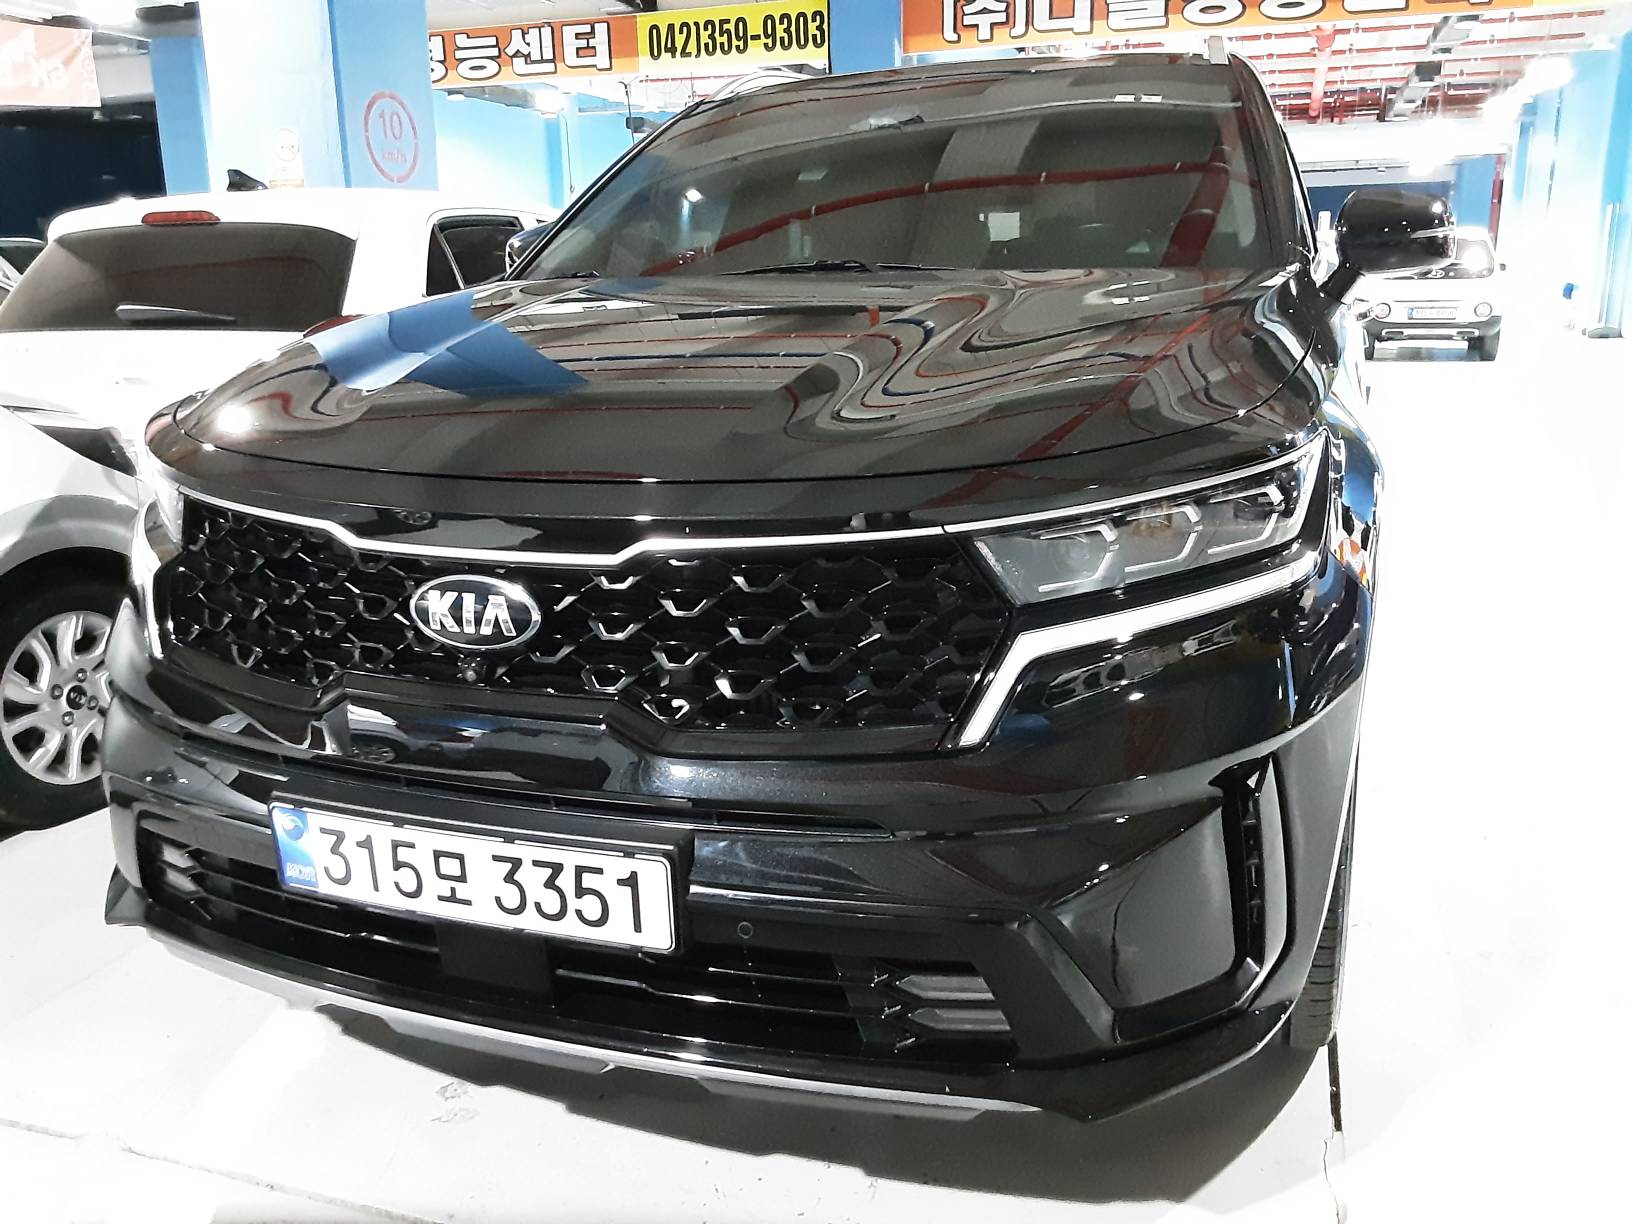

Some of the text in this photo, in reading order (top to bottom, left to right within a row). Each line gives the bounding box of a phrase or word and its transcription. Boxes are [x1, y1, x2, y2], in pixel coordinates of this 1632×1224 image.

[648, 10, 826, 61] 042)359-9303
[378, 109, 403, 141] 10
[427, 589, 517, 637] KIA
[318, 826, 643, 934] 315모 3351
